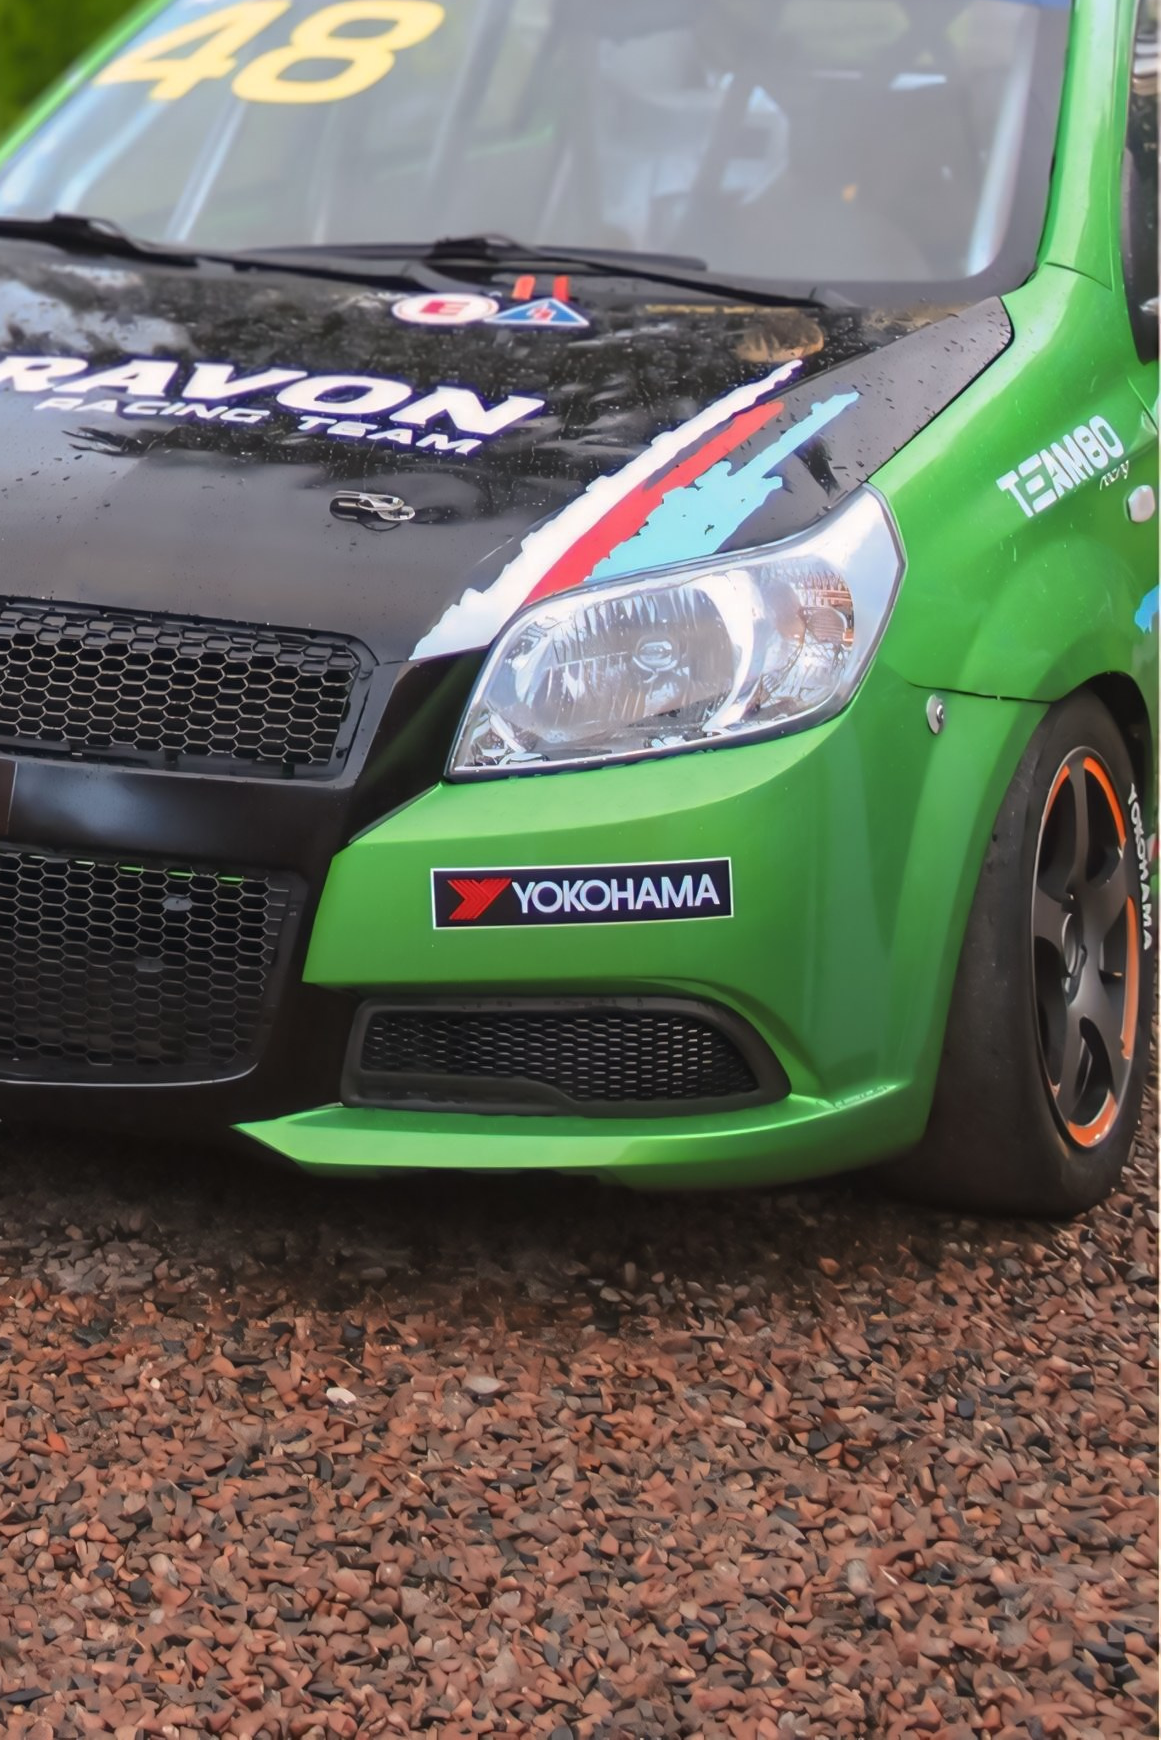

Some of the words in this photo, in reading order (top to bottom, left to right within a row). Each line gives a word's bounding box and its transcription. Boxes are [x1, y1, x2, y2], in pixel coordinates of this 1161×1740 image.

[33, 397, 272, 425] RACING
[297, 415, 484, 457] TEAM
[511, 873, 721, 915] YOKOHAMA
[1127, 782, 1153, 952] YOKOHAMA
